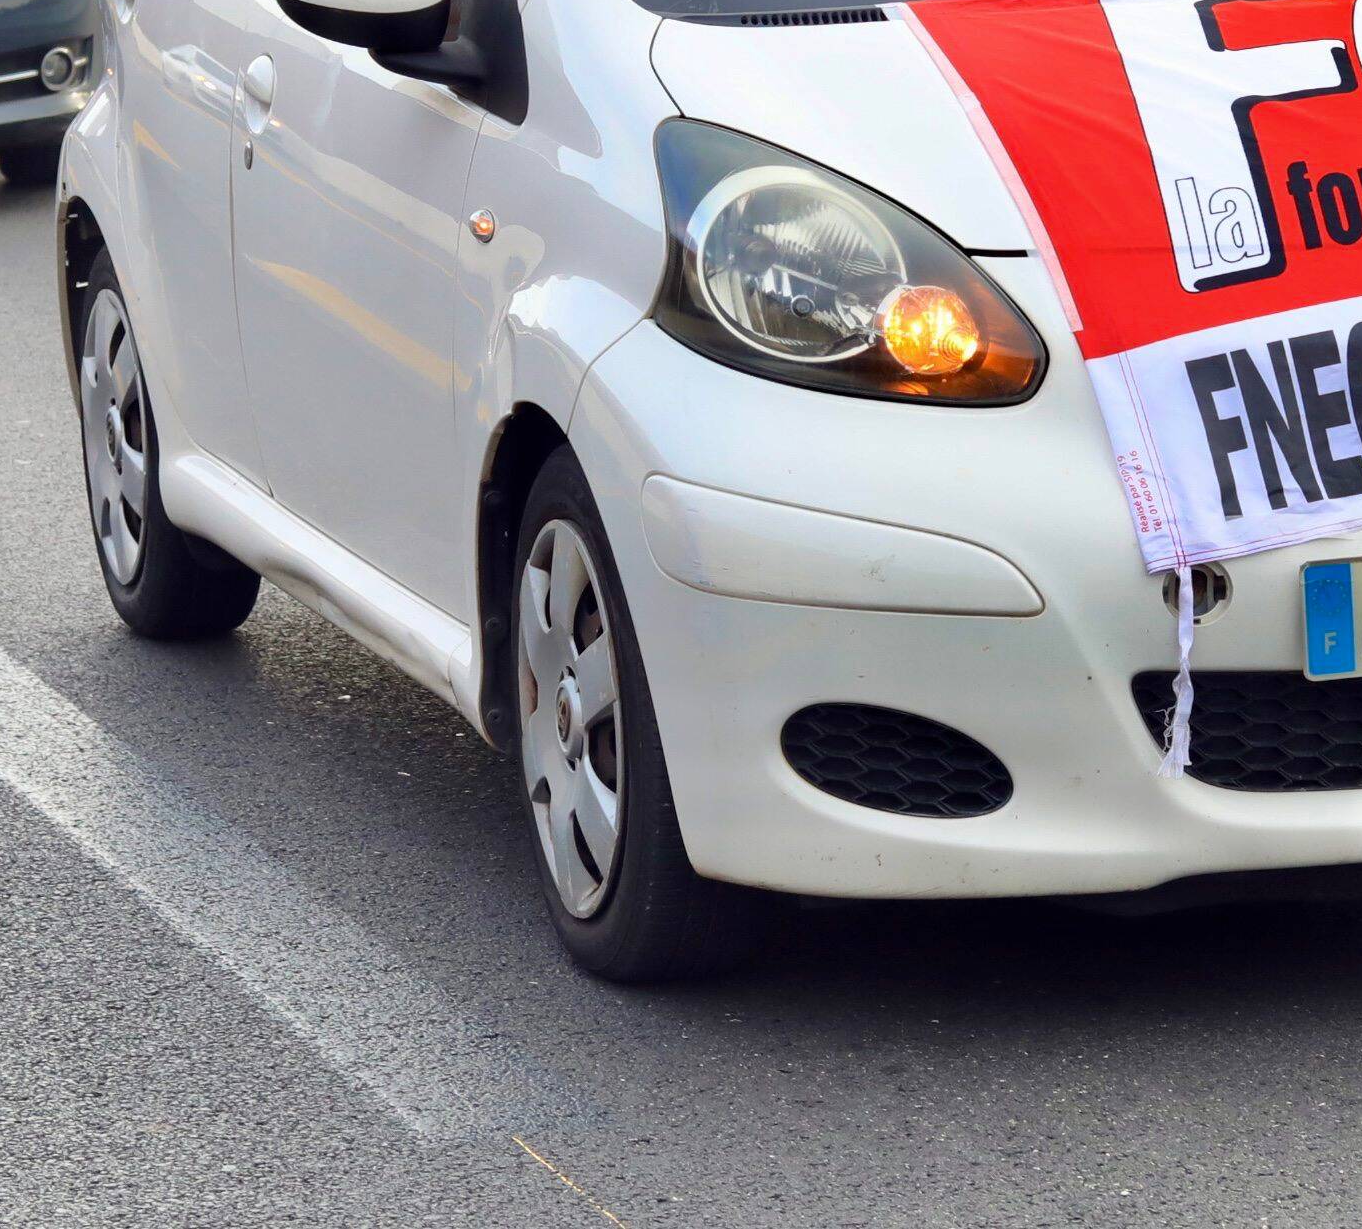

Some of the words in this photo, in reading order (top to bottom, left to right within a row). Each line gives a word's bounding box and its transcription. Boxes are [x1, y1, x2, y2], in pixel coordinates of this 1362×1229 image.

[1175, 176, 1267, 270] la
[1128, 484, 1142, 500] par
[1322, 632, 1337, 656] F
